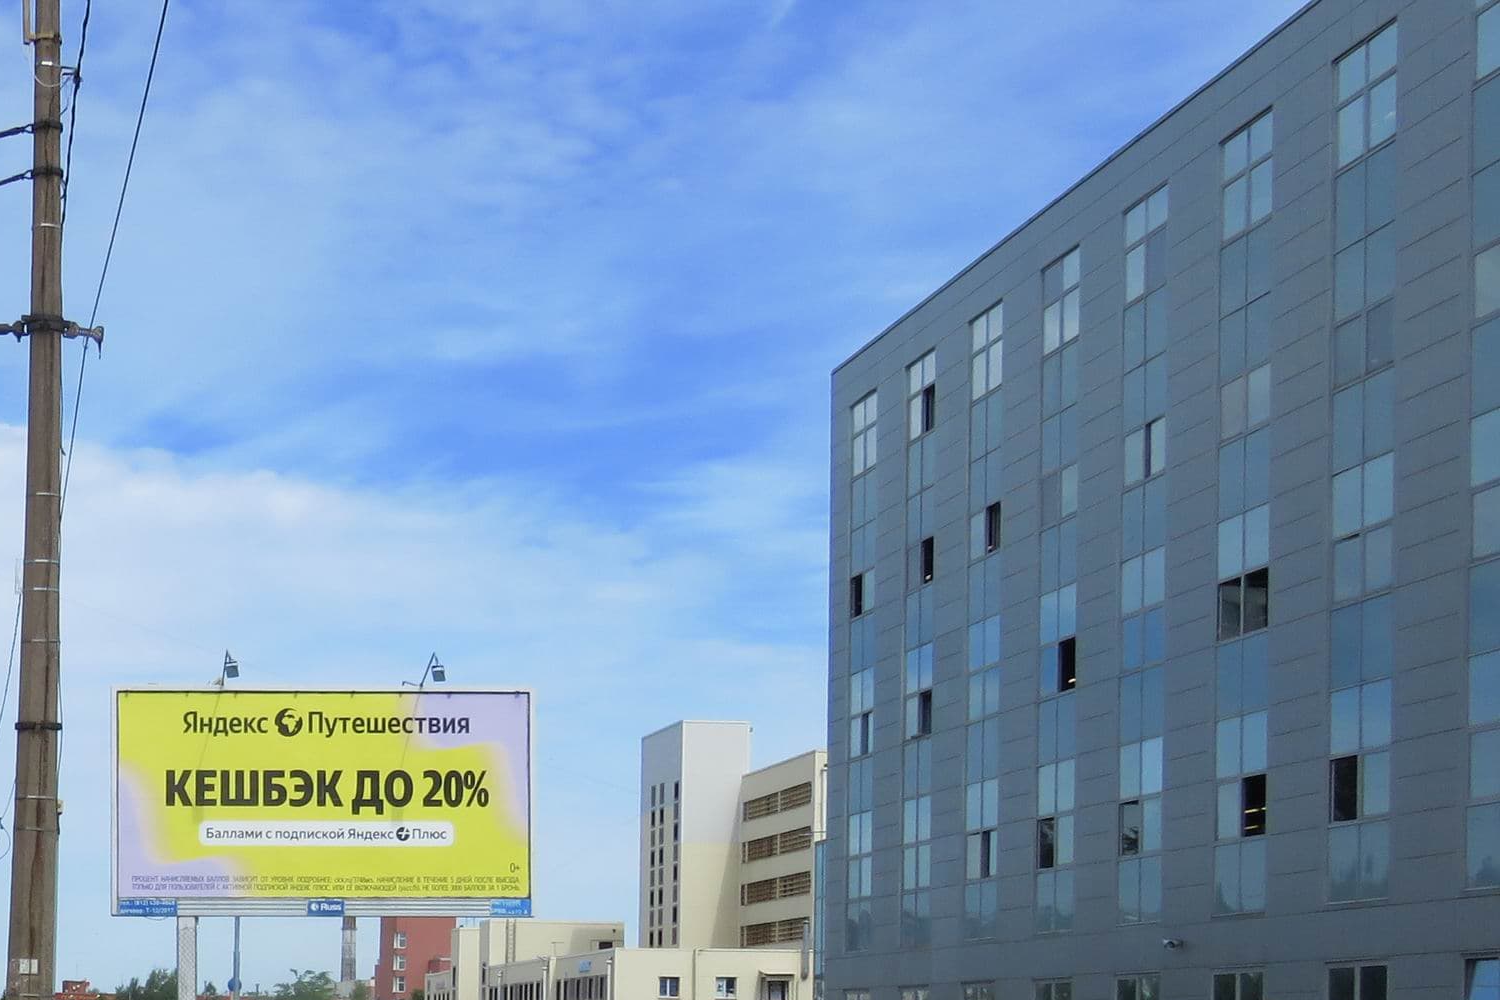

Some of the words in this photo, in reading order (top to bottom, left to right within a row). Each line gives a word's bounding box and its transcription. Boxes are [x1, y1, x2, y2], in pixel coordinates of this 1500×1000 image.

[183, 711, 269, 737] Яндекс
[308, 711, 470, 738] Путешествия
[165, 769, 344, 807] КЕШБЭК
[351, 769, 414, 815] ДО
[422, 769, 489, 808] 20%
[206, 827, 263, 839] Баллами
[265, 830, 273, 839] с
[275, 828, 346, 841] подпиской
[347, 828, 395, 841] Яндекс
[412, 828, 447, 840] Плюс
[509, 862, 520, 873] 0+
[320, 903, 342, 911] Russ
